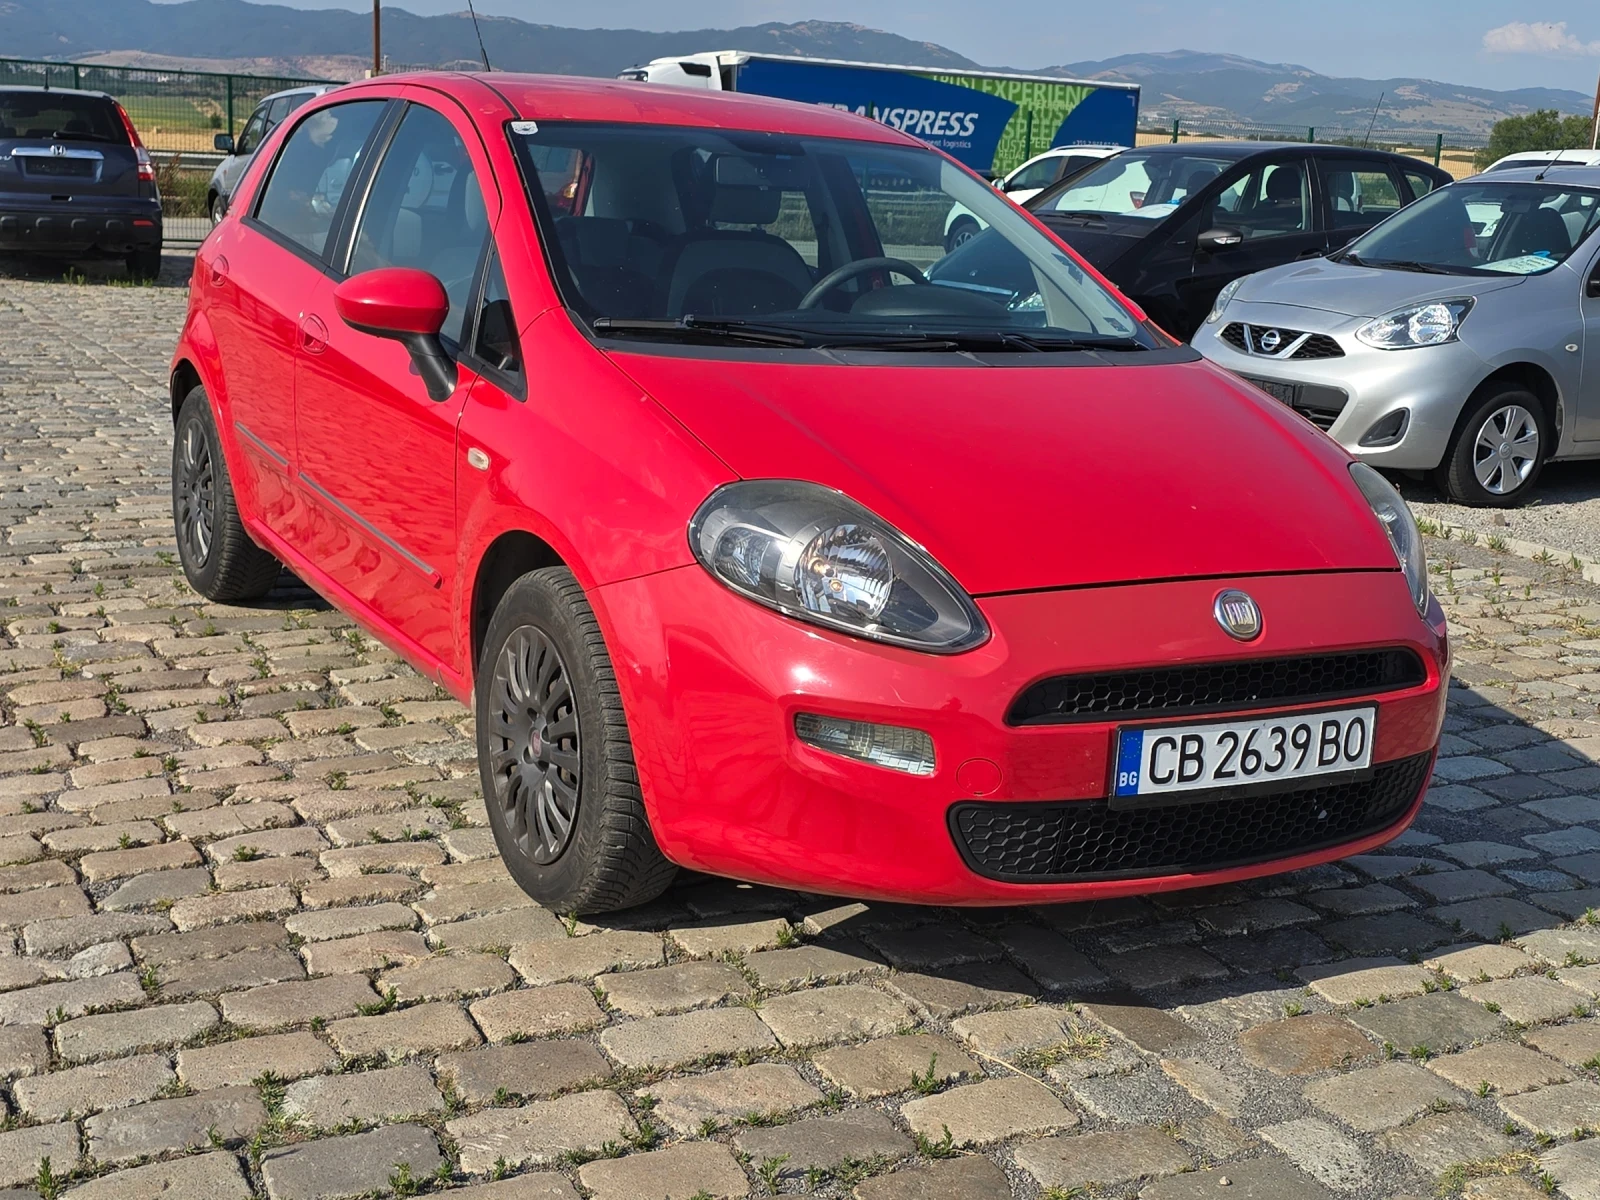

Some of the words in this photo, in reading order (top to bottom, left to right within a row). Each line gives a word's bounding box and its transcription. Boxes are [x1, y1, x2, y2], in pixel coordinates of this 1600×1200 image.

[817, 101, 978, 137] ANSPRESS
[943, 138, 972, 149] logistics
[1149, 734, 1204, 785] CB
[1212, 723, 1312, 780] 2639
[1316, 716, 1366, 768] BO
[1118, 771, 1138, 787] BG
